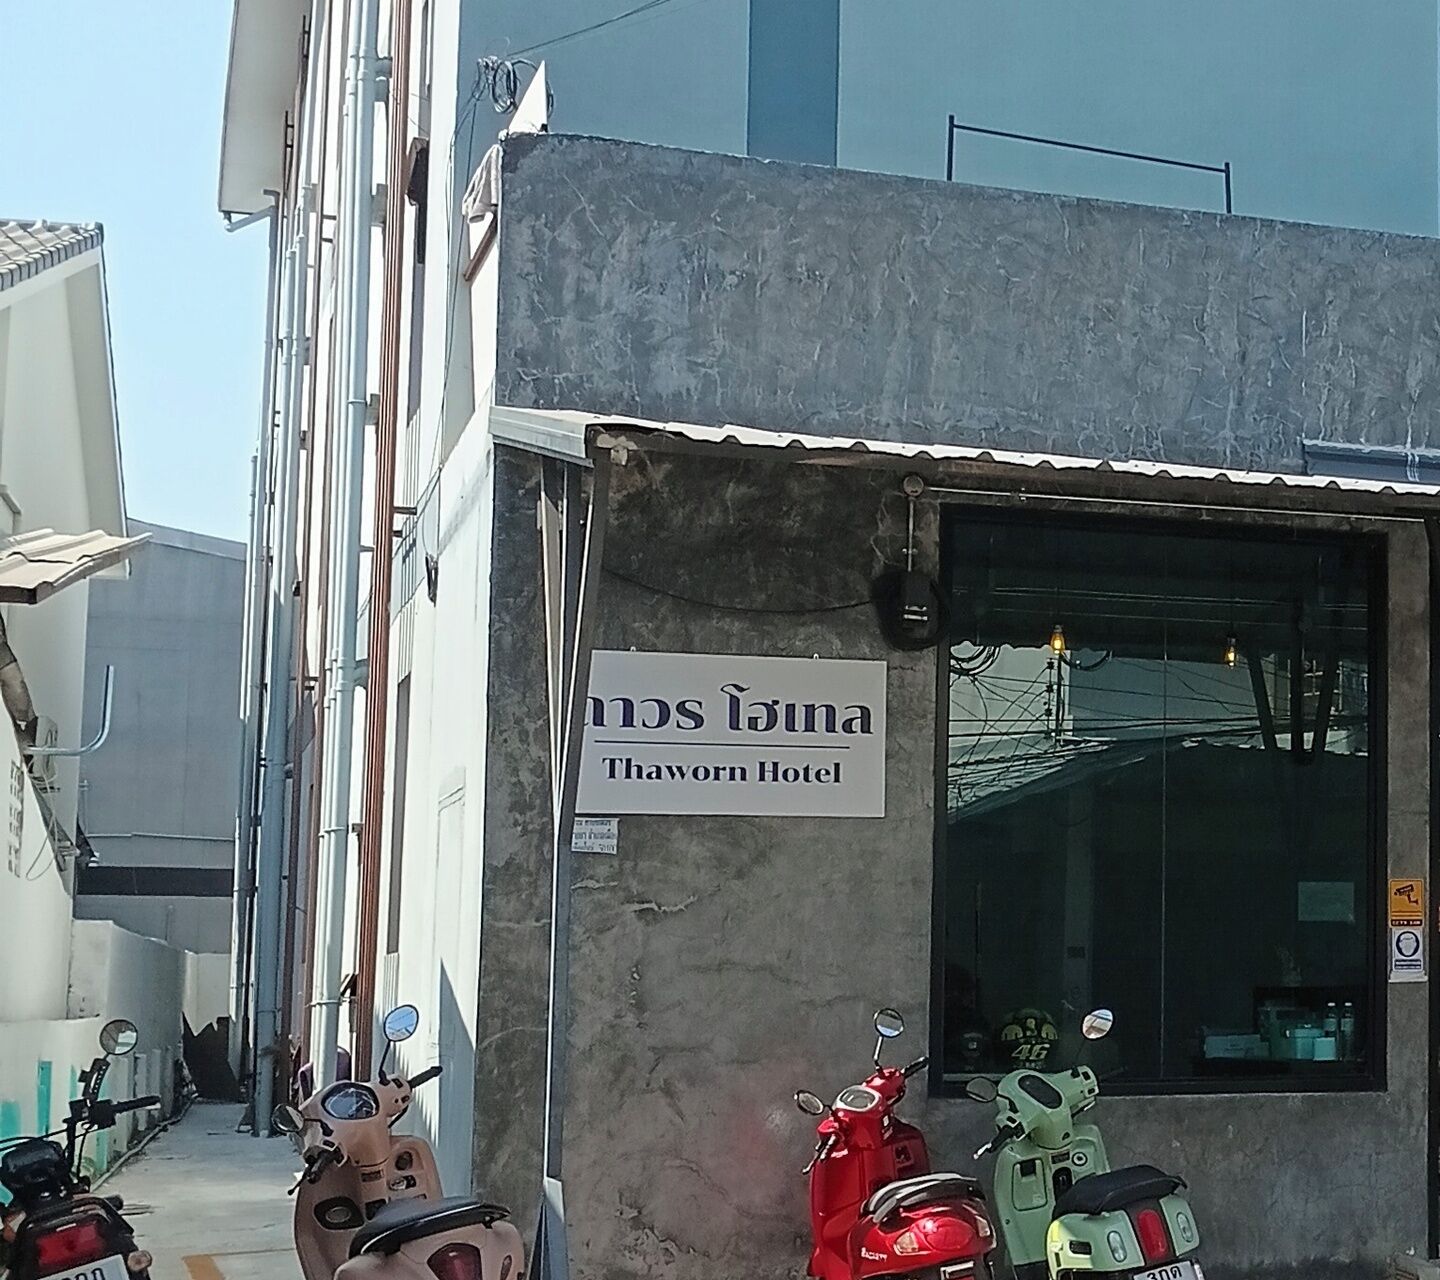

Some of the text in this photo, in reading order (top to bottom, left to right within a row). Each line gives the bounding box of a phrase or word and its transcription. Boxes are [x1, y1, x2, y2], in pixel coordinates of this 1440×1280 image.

[720, 683, 874, 734] โฮเทล
[602, 757, 842, 783] Thaworn Hotel
[1011, 1043, 1050, 1060] 46
